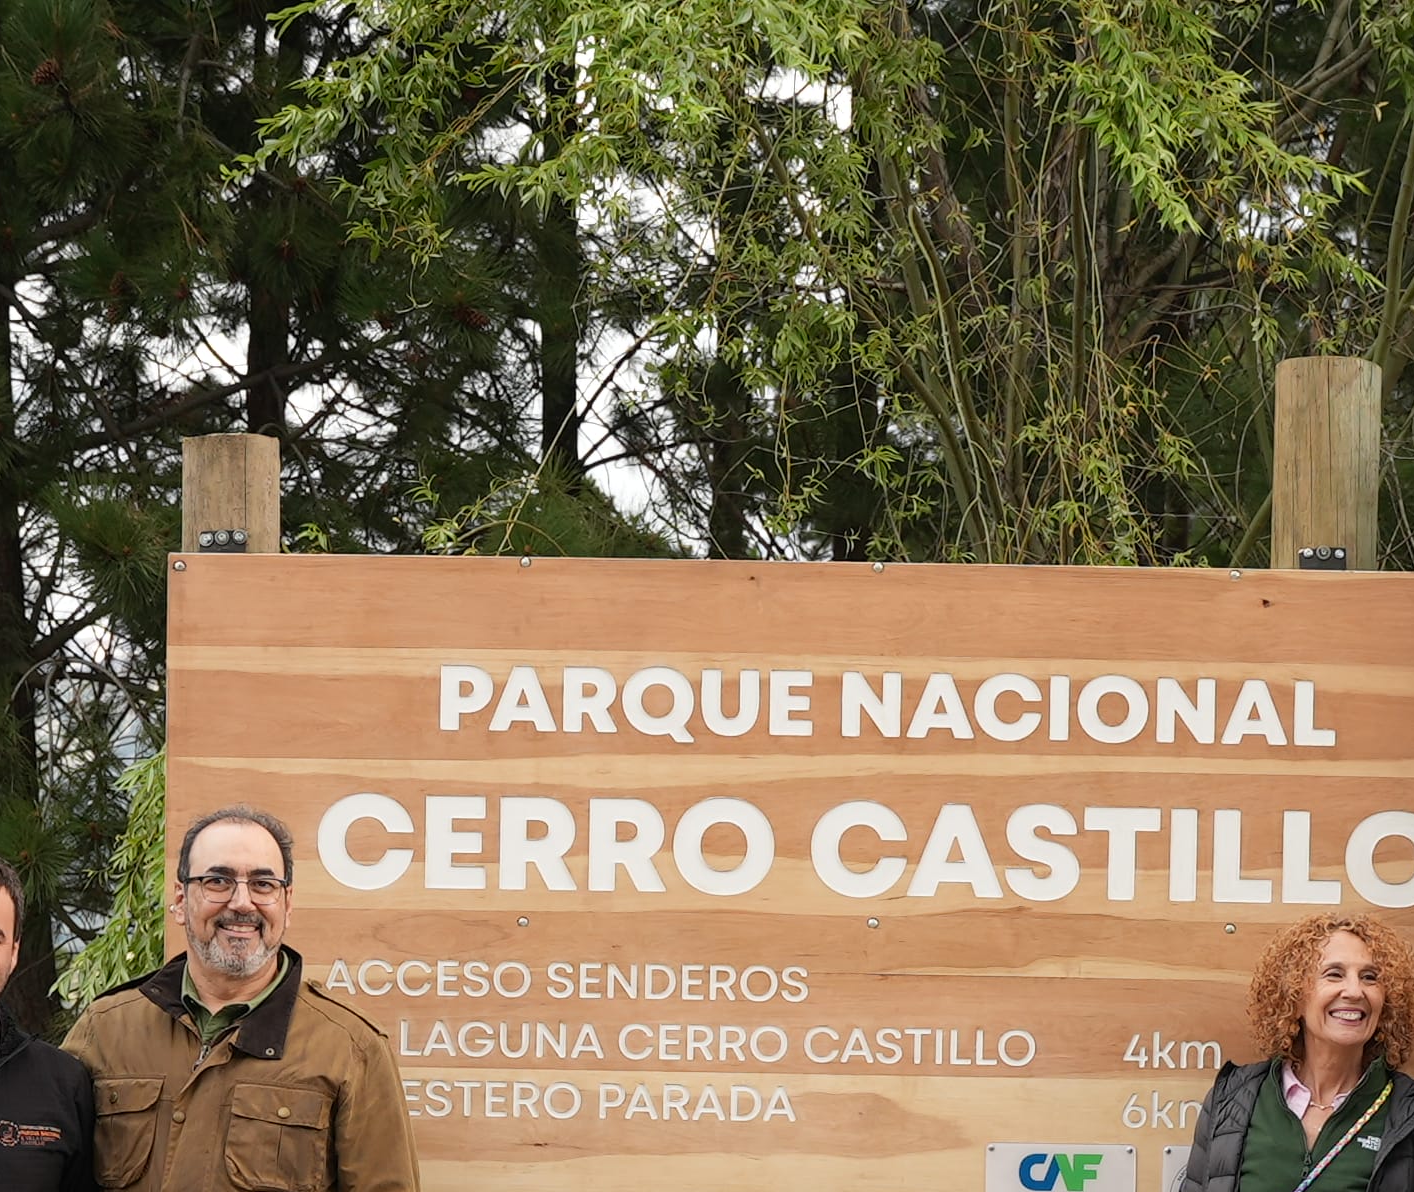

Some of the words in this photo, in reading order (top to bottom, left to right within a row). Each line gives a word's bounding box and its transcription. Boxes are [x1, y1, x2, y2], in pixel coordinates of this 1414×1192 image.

[439, 664, 814, 743] PARQUE
[841, 671, 1337, 747] NACIONAL
[316, 792, 776, 897] CERRO
[324, 958, 533, 999] ACCESO
[545, 961, 810, 1003] SENDEROS
[398, 1018, 605, 1059] LAGUNA
[618, 1022, 788, 1063] CERRO
[802, 1025, 1037, 1067] CASTILLO
[1122, 1031, 1222, 1070] 4km
[402, 1078, 582, 1120] ESTERO
[598, 1081, 797, 1122] PARADA
[1018, 1153, 1104, 1192] CAF
